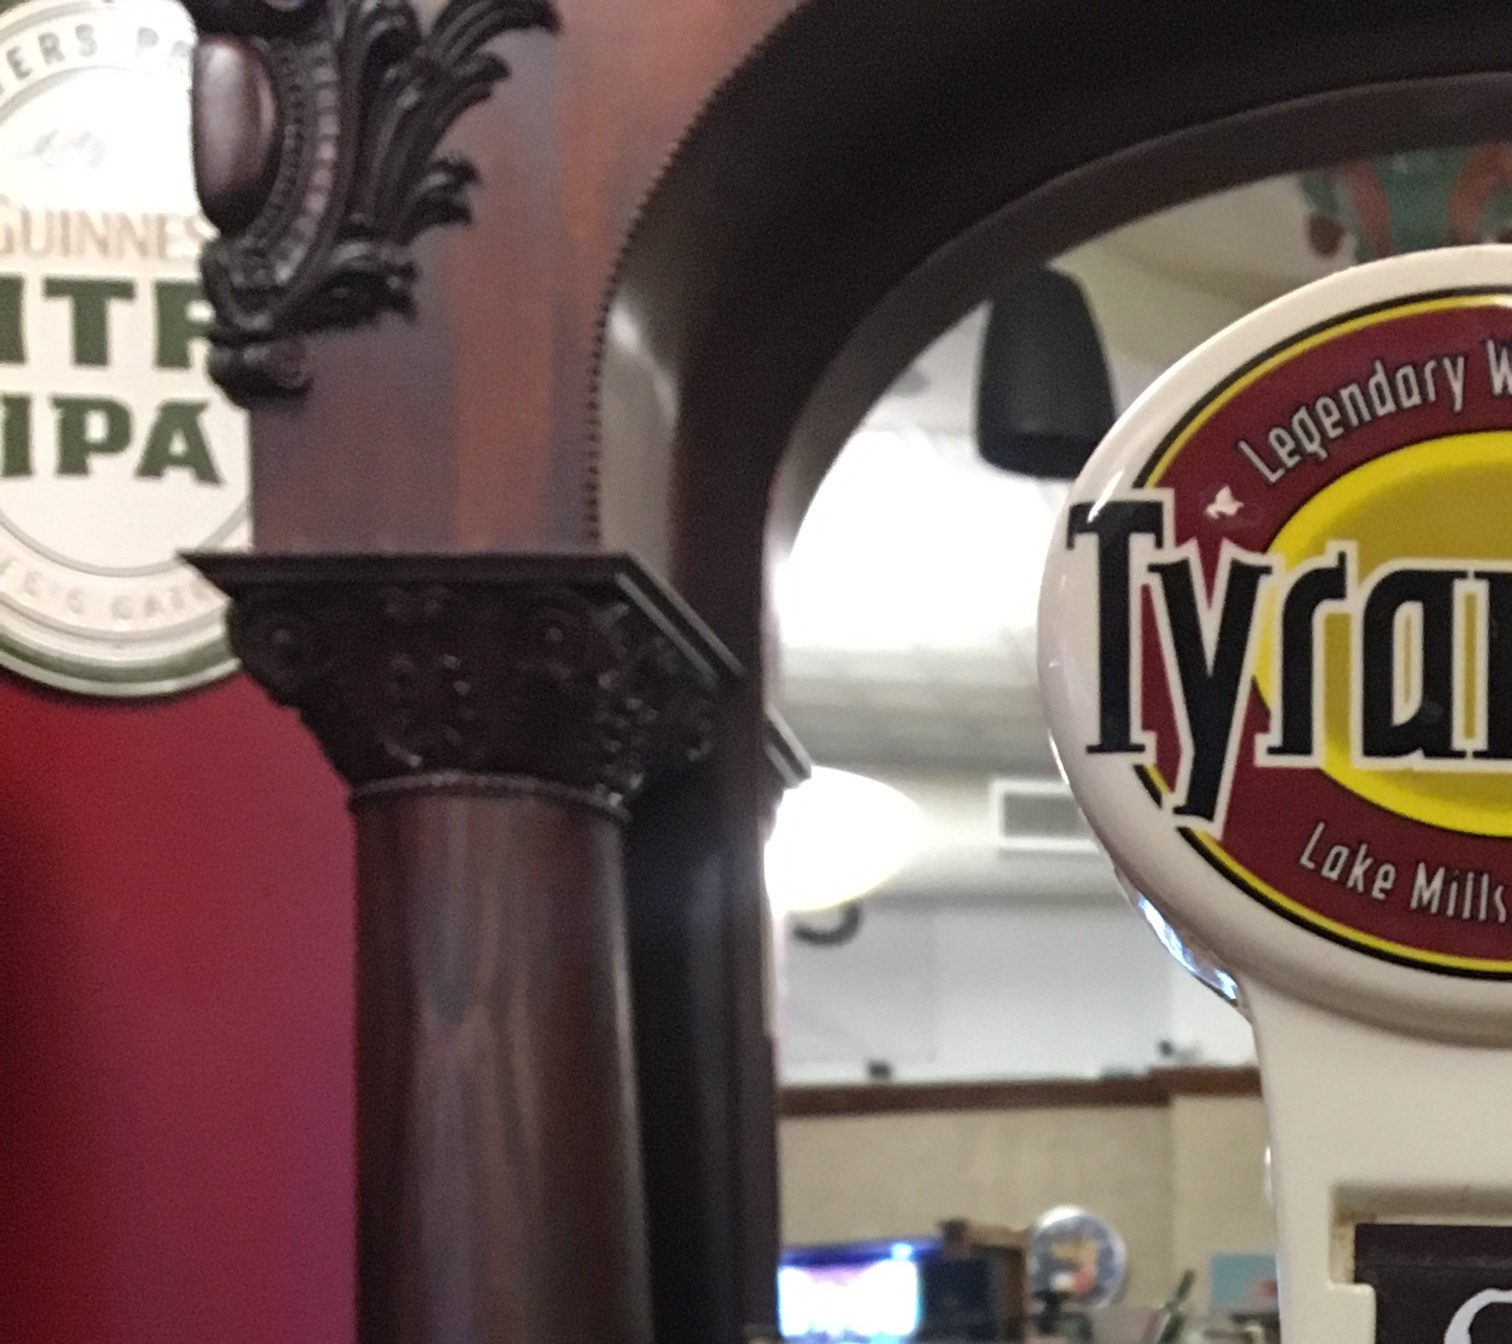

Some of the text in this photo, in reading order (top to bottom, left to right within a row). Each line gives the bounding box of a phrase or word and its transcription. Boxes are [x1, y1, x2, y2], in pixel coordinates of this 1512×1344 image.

[0, 395, 223, 484] IPA
[1238, 359, 1465, 484] Legendary
[1299, 822, 1396, 901] Lake
